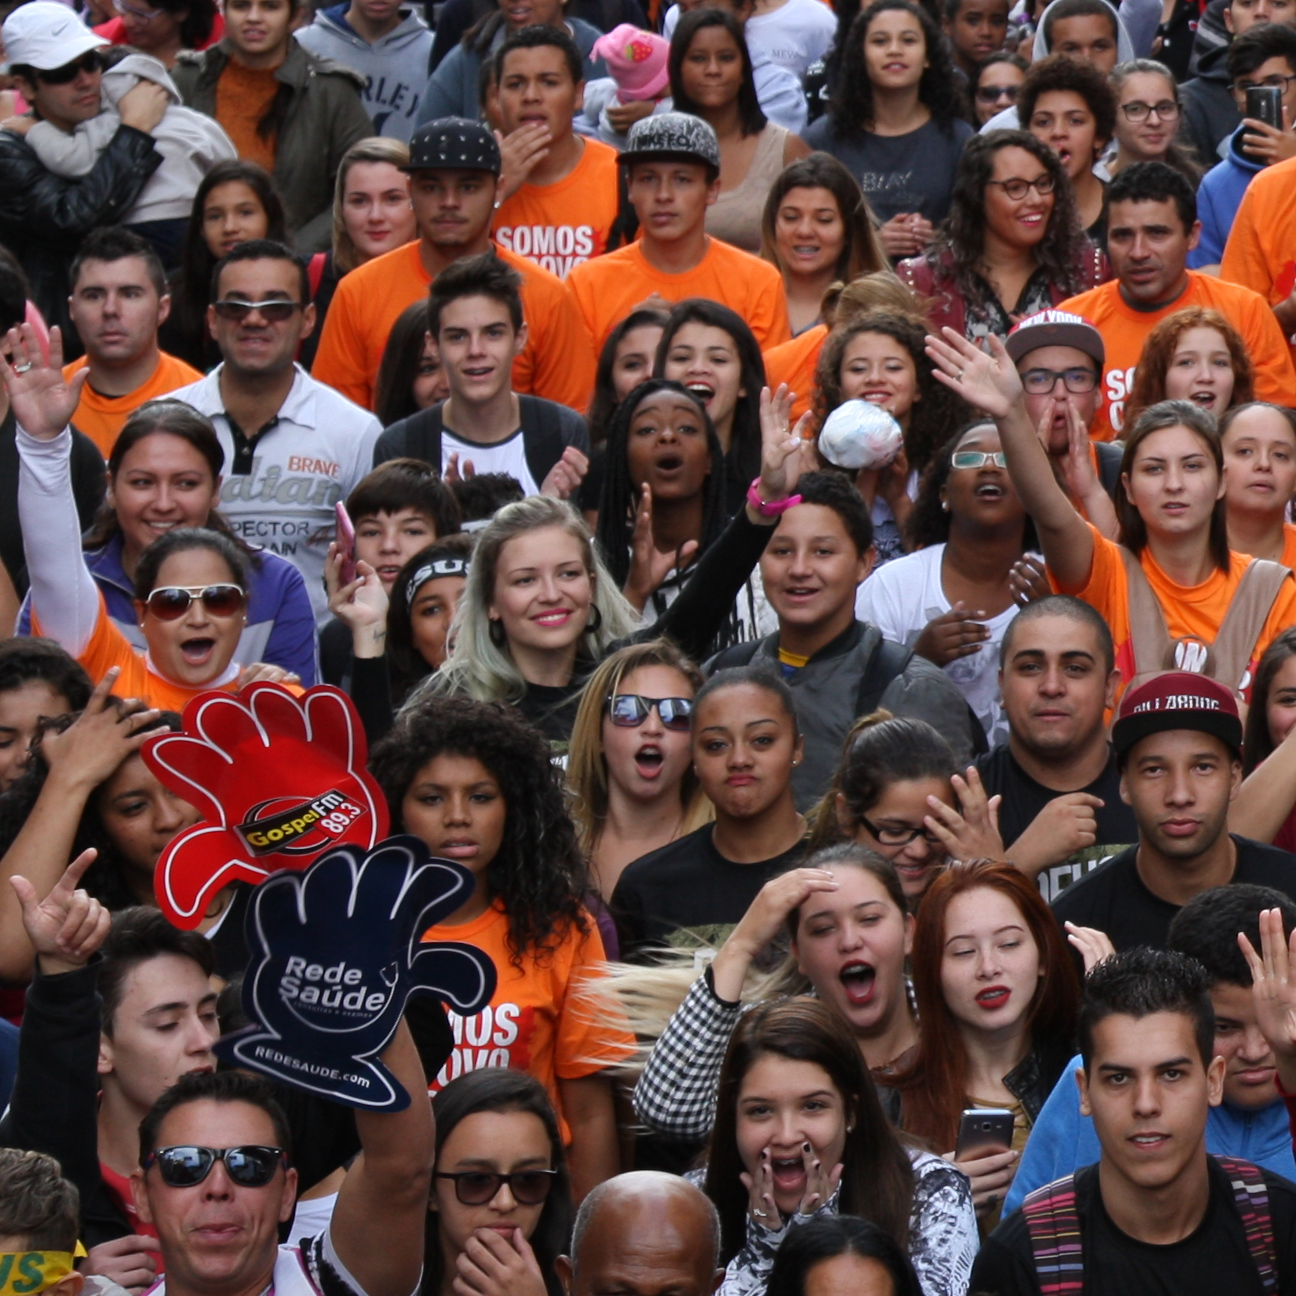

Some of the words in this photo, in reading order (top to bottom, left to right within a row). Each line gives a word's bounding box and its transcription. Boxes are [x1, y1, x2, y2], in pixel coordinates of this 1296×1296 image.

[362, 76, 420, 119] RLEY
[494, 225, 592, 258] SOMOS
[288, 456, 341, 477] BRAVE
[320, 801, 362, 835] 89.3
[284, 956, 363, 987] Rede
[280, 976, 387, 1013] Saúde
[254, 1045, 371, 1089] REDESAUDE.com
